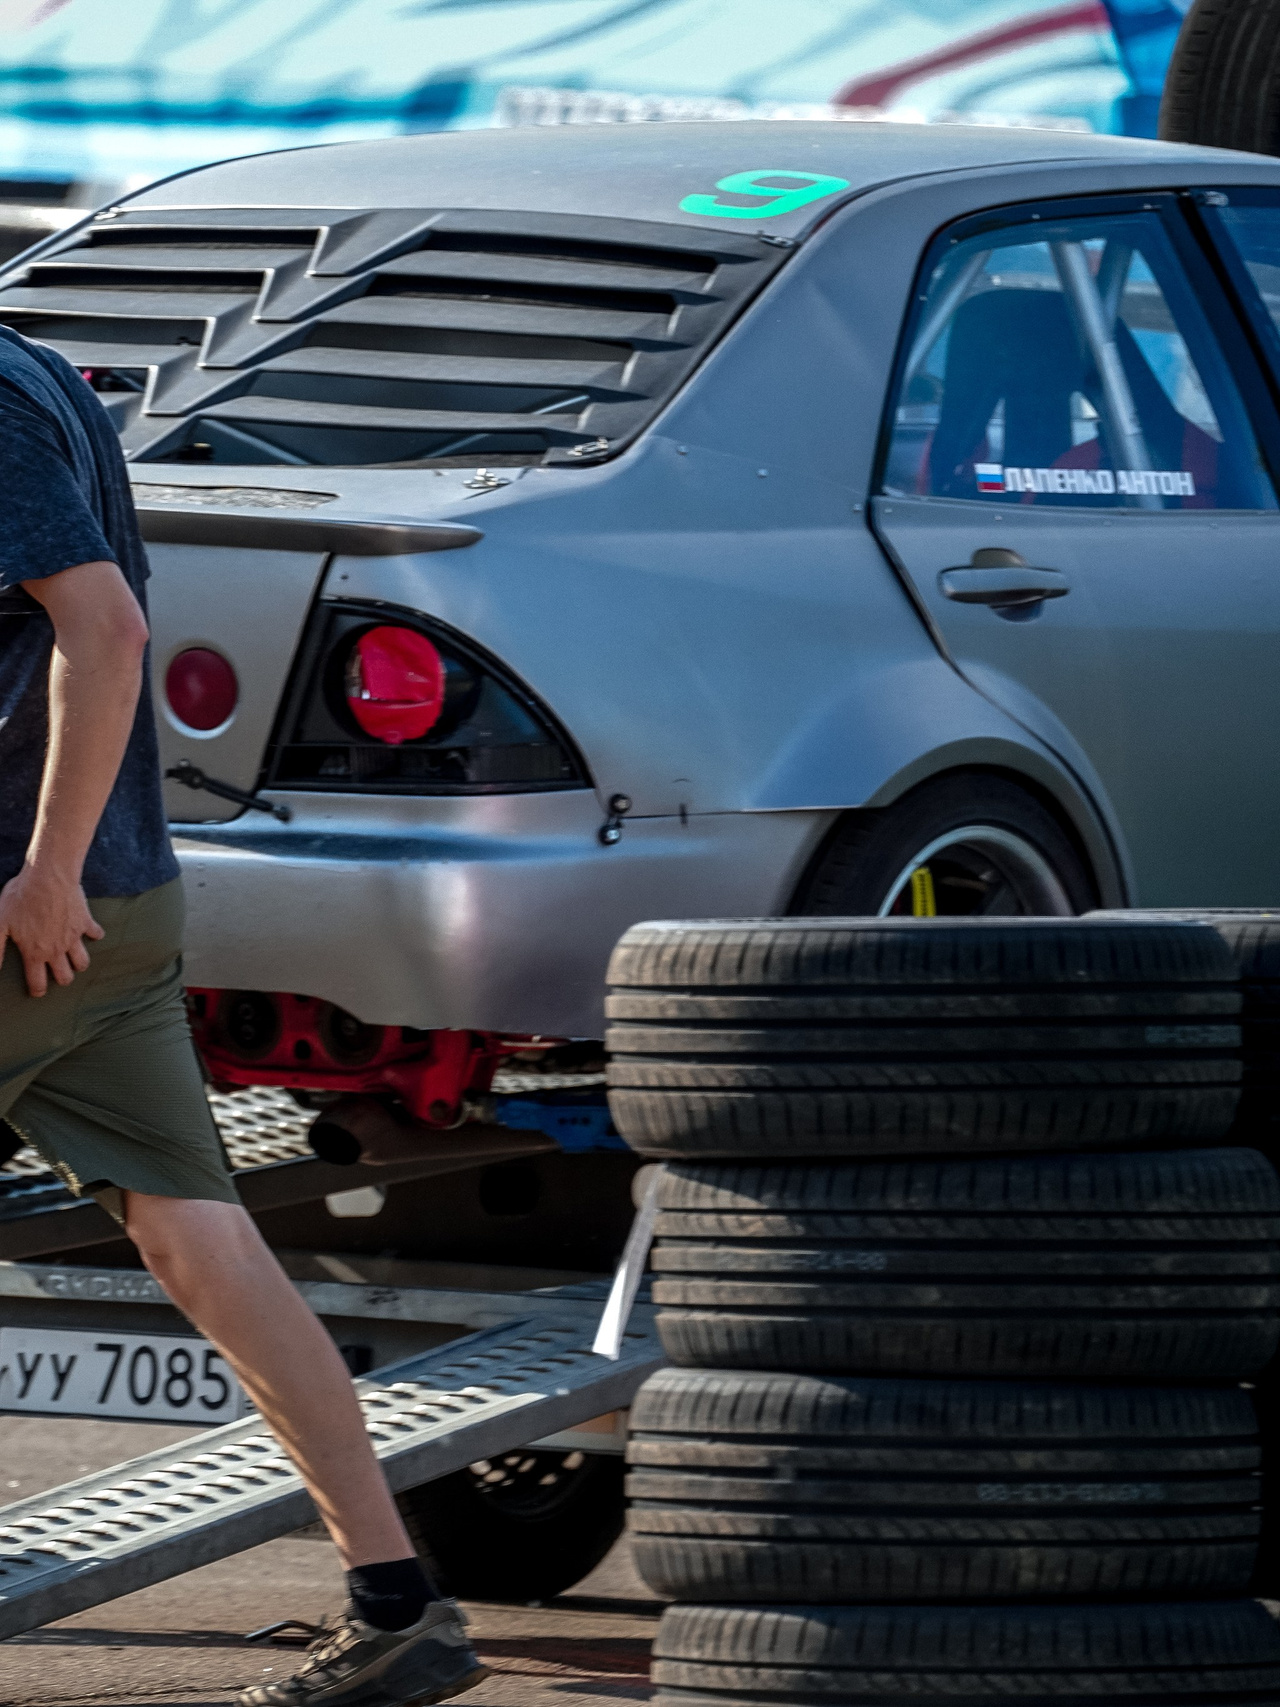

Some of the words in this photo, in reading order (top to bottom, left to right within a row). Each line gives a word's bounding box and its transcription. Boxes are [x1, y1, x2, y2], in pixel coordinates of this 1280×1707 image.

[679, 169, 851, 220] 9
[1116, 470, 1196, 496] АНТОН
[94, 1343, 229, 1411] 7085
